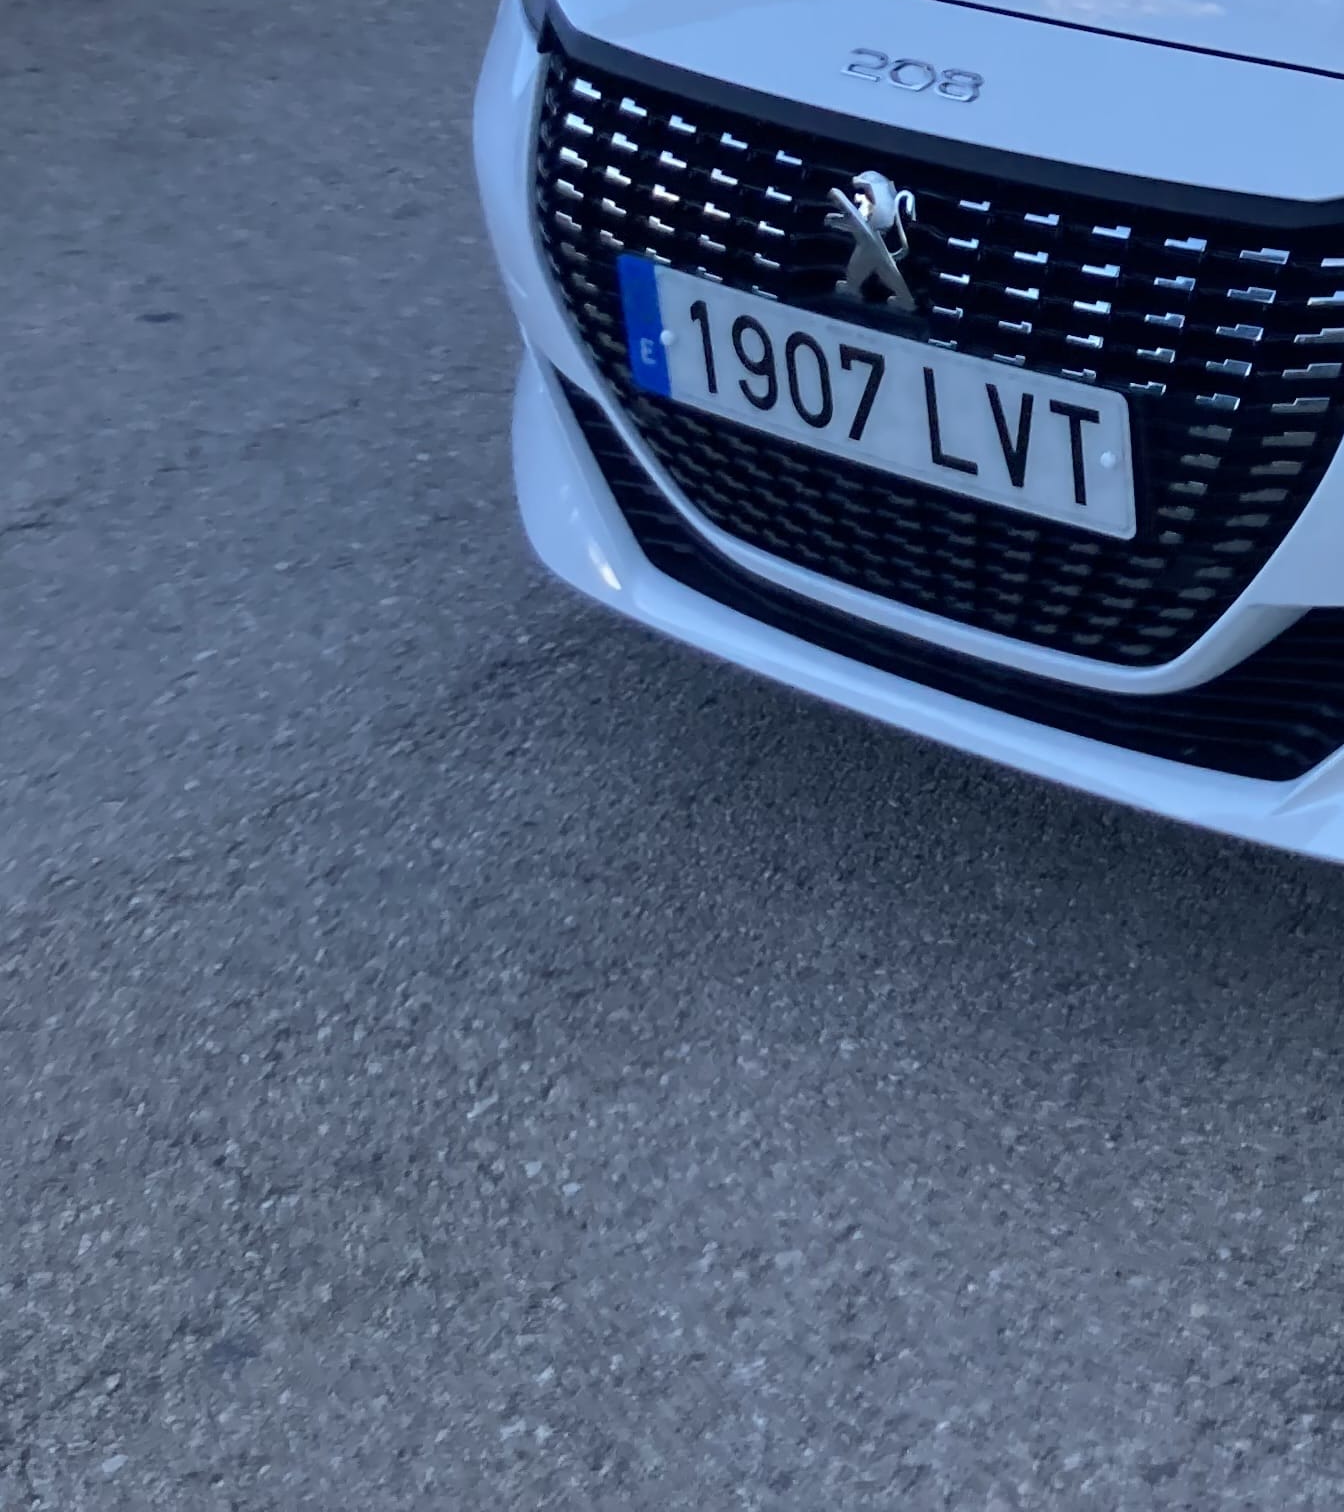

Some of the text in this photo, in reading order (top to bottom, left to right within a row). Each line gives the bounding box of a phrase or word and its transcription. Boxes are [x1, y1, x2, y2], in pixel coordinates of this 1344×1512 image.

[839, 46, 985, 104] 208
[640, 299, 1101, 507] E 1907 LVT
